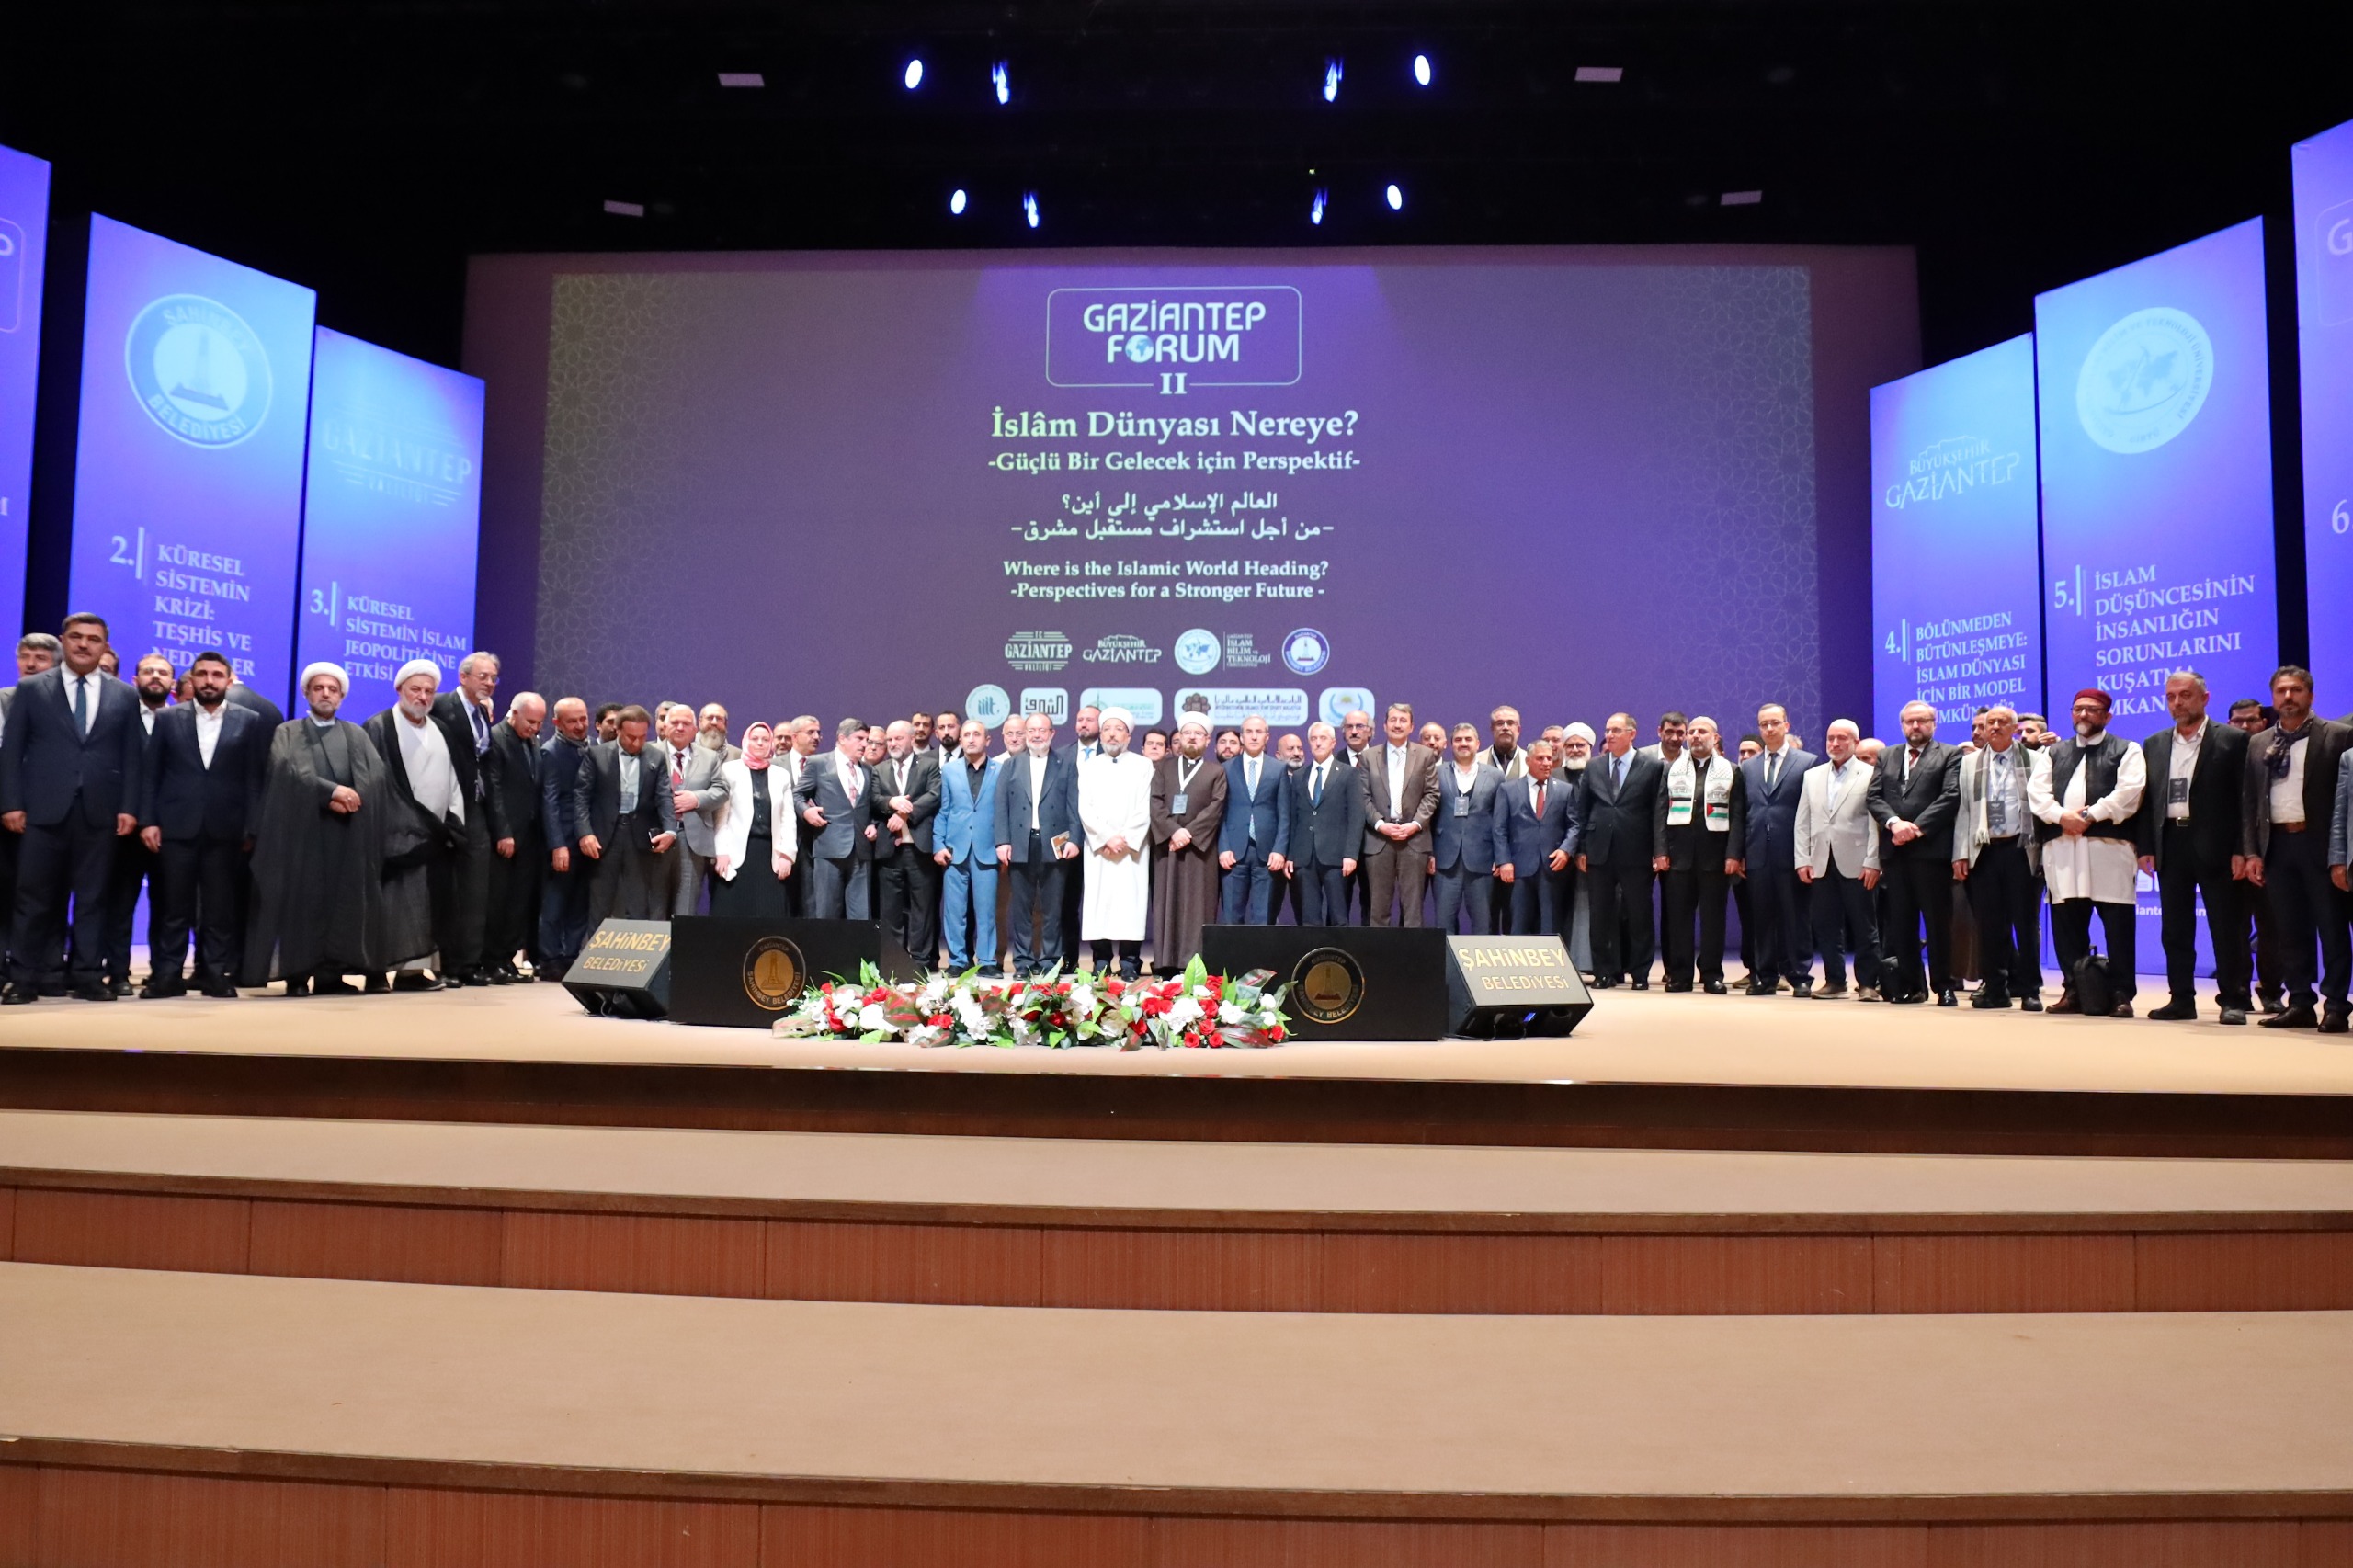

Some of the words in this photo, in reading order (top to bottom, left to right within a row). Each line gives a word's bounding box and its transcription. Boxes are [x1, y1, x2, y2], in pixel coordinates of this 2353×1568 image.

[1084, 299, 1266, 332] GAZİANTEP
[1108, 334, 1239, 363] FORUM
[1160, 373, 1187, 394] II
[992, 406, 1077, 437] İslâm
[1087, 412, 1220, 444] Dünyası
[1231, 411, 1358, 444] Nereye?
[988, 452, 1060, 474] -Güçlü
[1068, 452, 1099, 470] Bir
[1105, 451, 1190, 470] Gelecek
[1198, 451, 1236, 474] için
[1244, 451, 1360, 474] Perspektif-
[1886, 452, 2019, 509] GAZİANTEP
[1144, 493, 1223, 520] الإسلامي
[1231, 492, 1278, 517] العالم
[1086, 518, 1153, 540] مستقبل
[1160, 518, 1244, 540] استشراف
[1251, 517, 1287, 540] أجل
[109, 536, 134, 566] 2.
[158, 544, 244, 576] KÜRESEL
[1004, 561, 1060, 575] Where
[1065, 561, 1079, 575] is
[1085, 561, 1111, 575] the
[1118, 561, 1180, 575] Islamic
[1186, 561, 1238, 575] World
[1245, 561, 1328, 580] Heading?
[2095, 565, 2155, 590] İSLAM
[155, 569, 250, 602] SİSTEMİN
[1011, 582, 1125, 602] -Perspectives
[1131, 582, 1156, 597] for
[1161, 586, 1169, 597] a
[1176, 582, 1251, 602] Stronger
[1256, 583, 1313, 597] Future
[2054, 581, 2074, 608] 5.
[2096, 574, 2255, 616] DÜŞÜNCESİNİN
[154, 596, 214, 620] KRİZİ:
[310, 589, 329, 615] 3.
[347, 596, 415, 620] KÜRESEL
[153, 620, 222, 646] TEŞHİS
[227, 631, 252, 651] VE
[346, 617, 418, 642] SİSTEMİN
[422, 628, 466, 651] İSLAM
[1916, 611, 2012, 642] BÖLÜNMEDEN
[2096, 608, 2219, 642] İNSANLIĞIN
[1005, 641, 1073, 659] GAZİANTEP
[1885, 631, 1901, 653] 4.
[1916, 632, 2027, 662] BÜTÜNLEŞMEYE:
[2097, 632, 2242, 666] SORUNLARINI
[344, 661, 393, 681] ETKİSİ
[1917, 665, 1958, 684] İSLAM
[1961, 654, 2025, 677] DÜNYASI
[1949, 683, 1971, 700] BİR
[1974, 677, 2026, 698] MODEL
